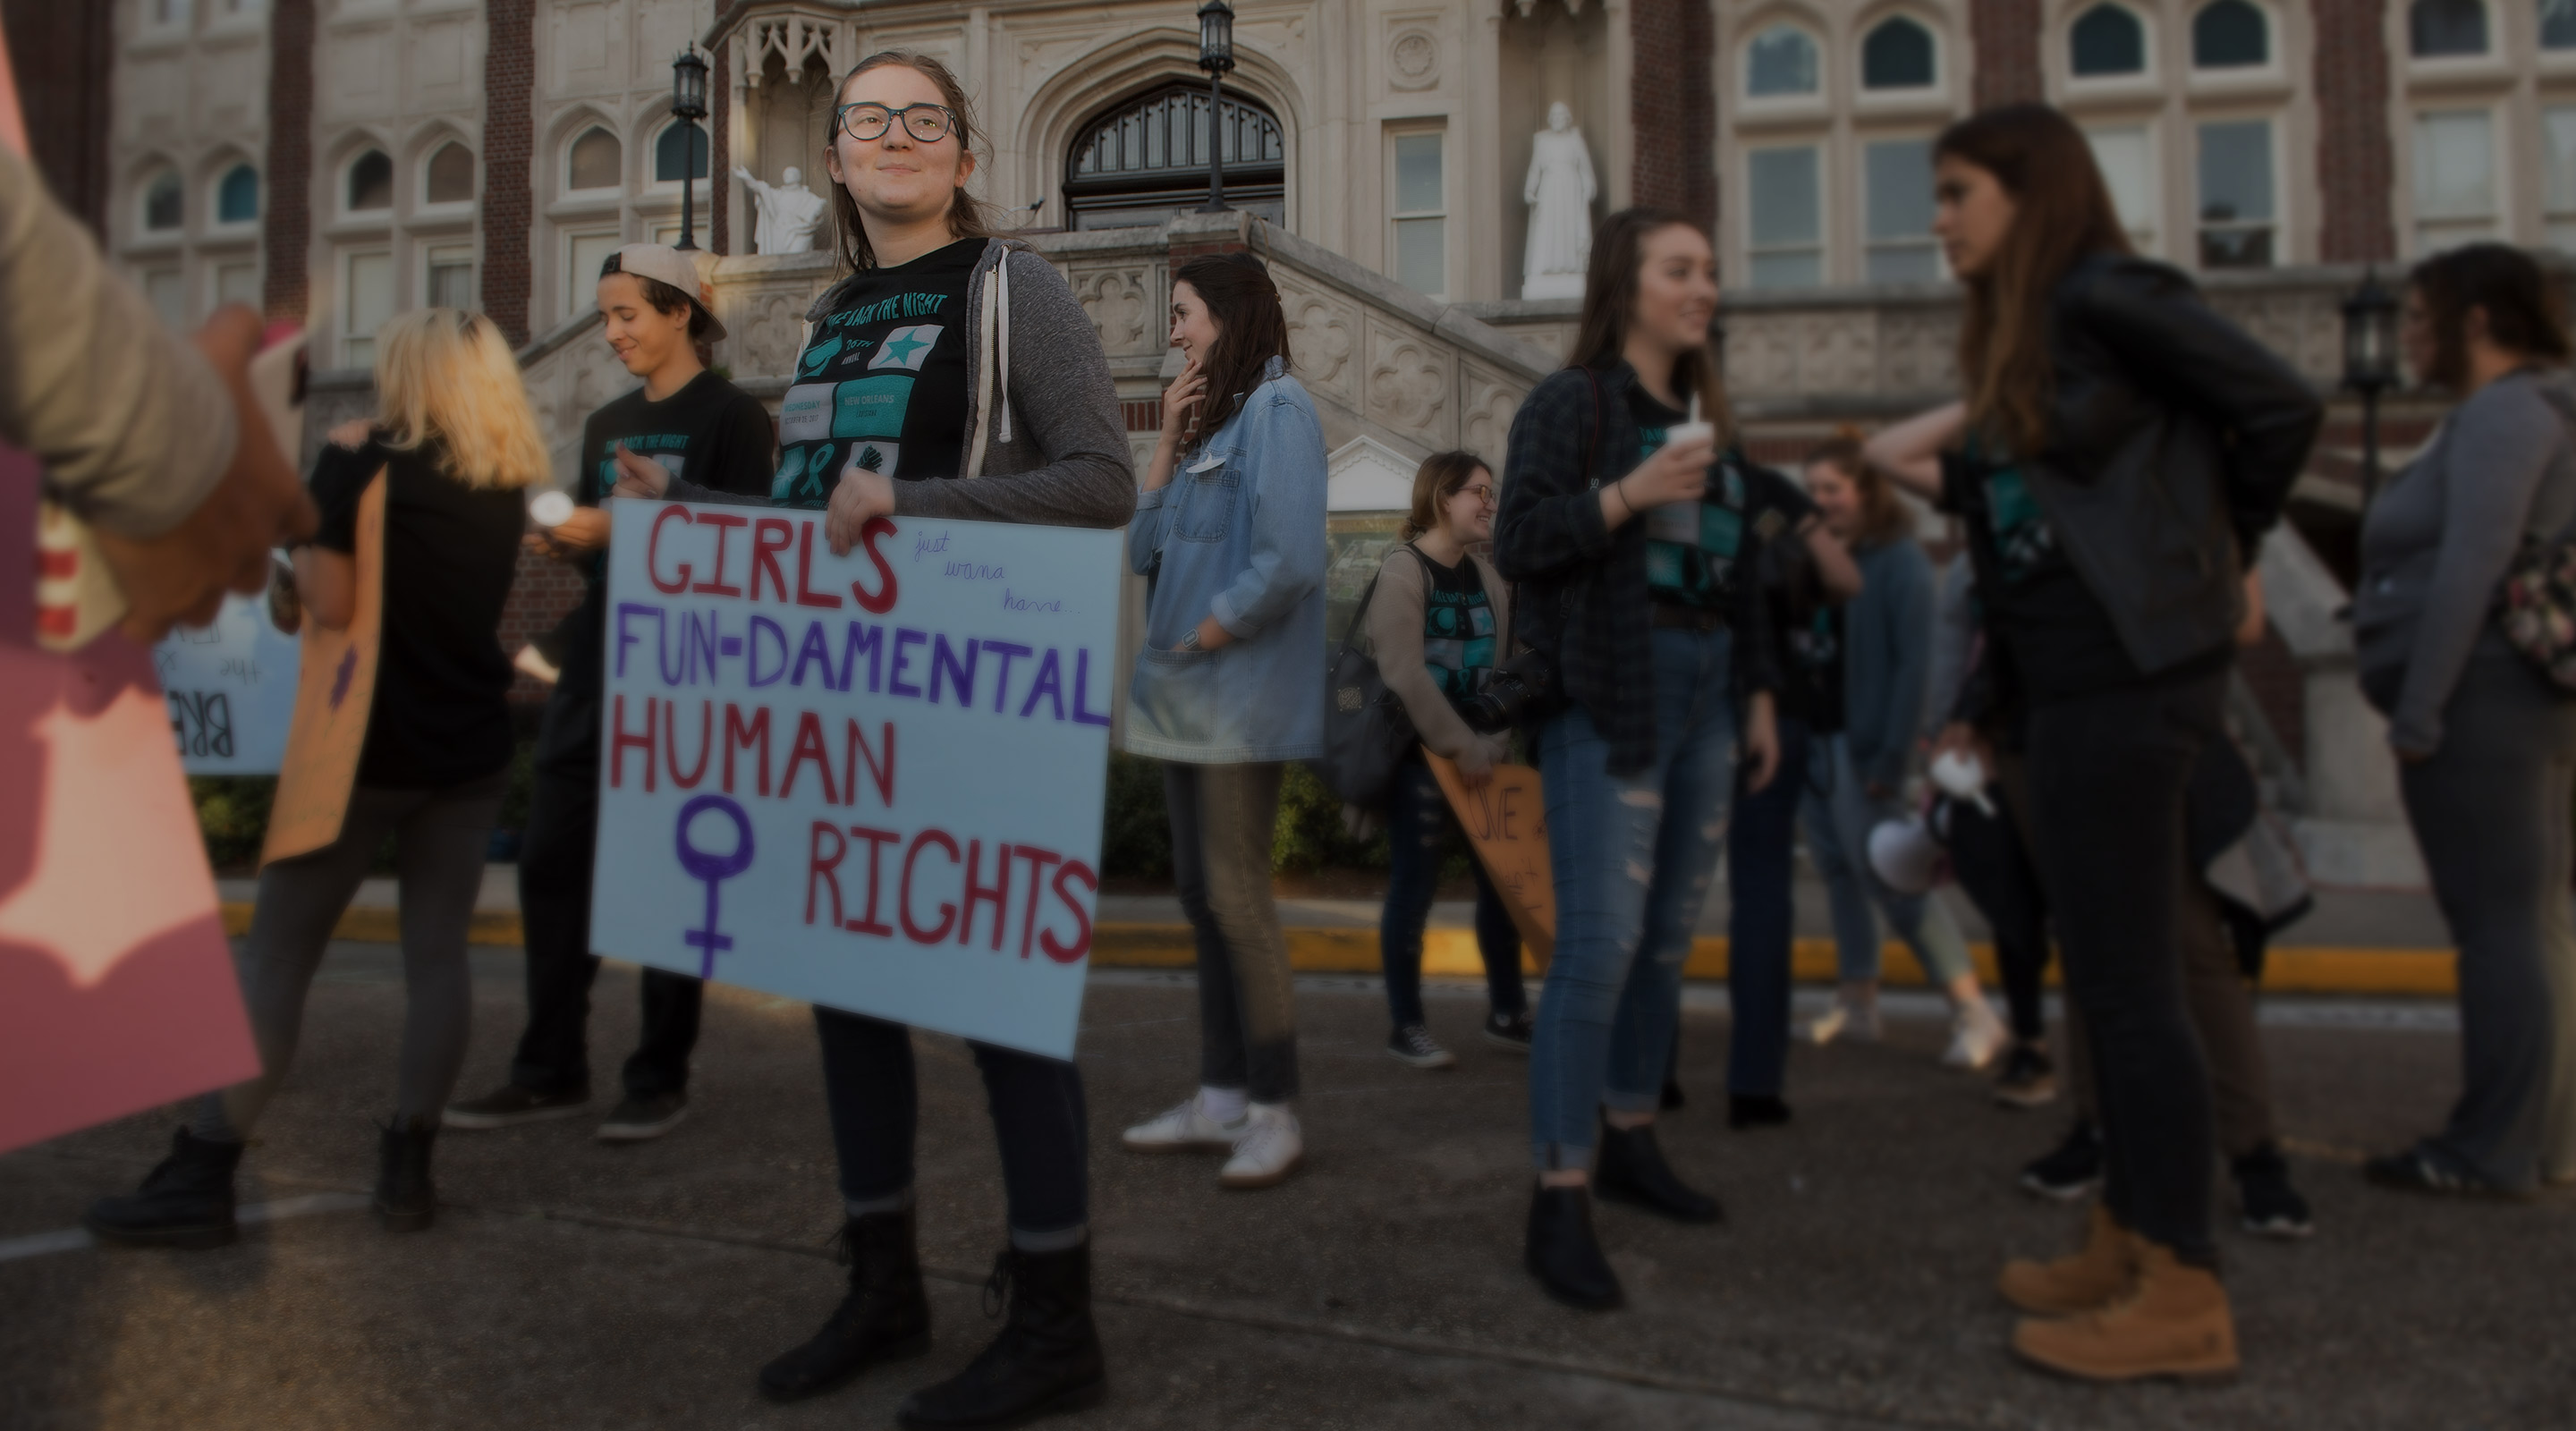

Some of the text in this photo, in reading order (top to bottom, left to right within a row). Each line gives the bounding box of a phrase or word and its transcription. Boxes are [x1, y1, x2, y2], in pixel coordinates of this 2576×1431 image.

[844, 302, 879, 326] BACK
[877, 295, 901, 321] THE
[902, 292, 948, 318] NIGHT
[784, 401, 820, 412] WEDNESDAY
[844, 394, 894, 406] NEW ORLEANS
[645, 434, 661, 449] THE
[660, 434, 690, 450] NIGHT
[648, 504, 898, 614] GIRLS
[914, 529, 950, 563] just
[945, 560, 1005, 580] wana
[220, 658, 262, 686] the
[616, 603, 1110, 728] FUN-DAMENTAL
[610, 694, 894, 808] HUMAN
[805, 820, 1098, 964] RIGHTS
